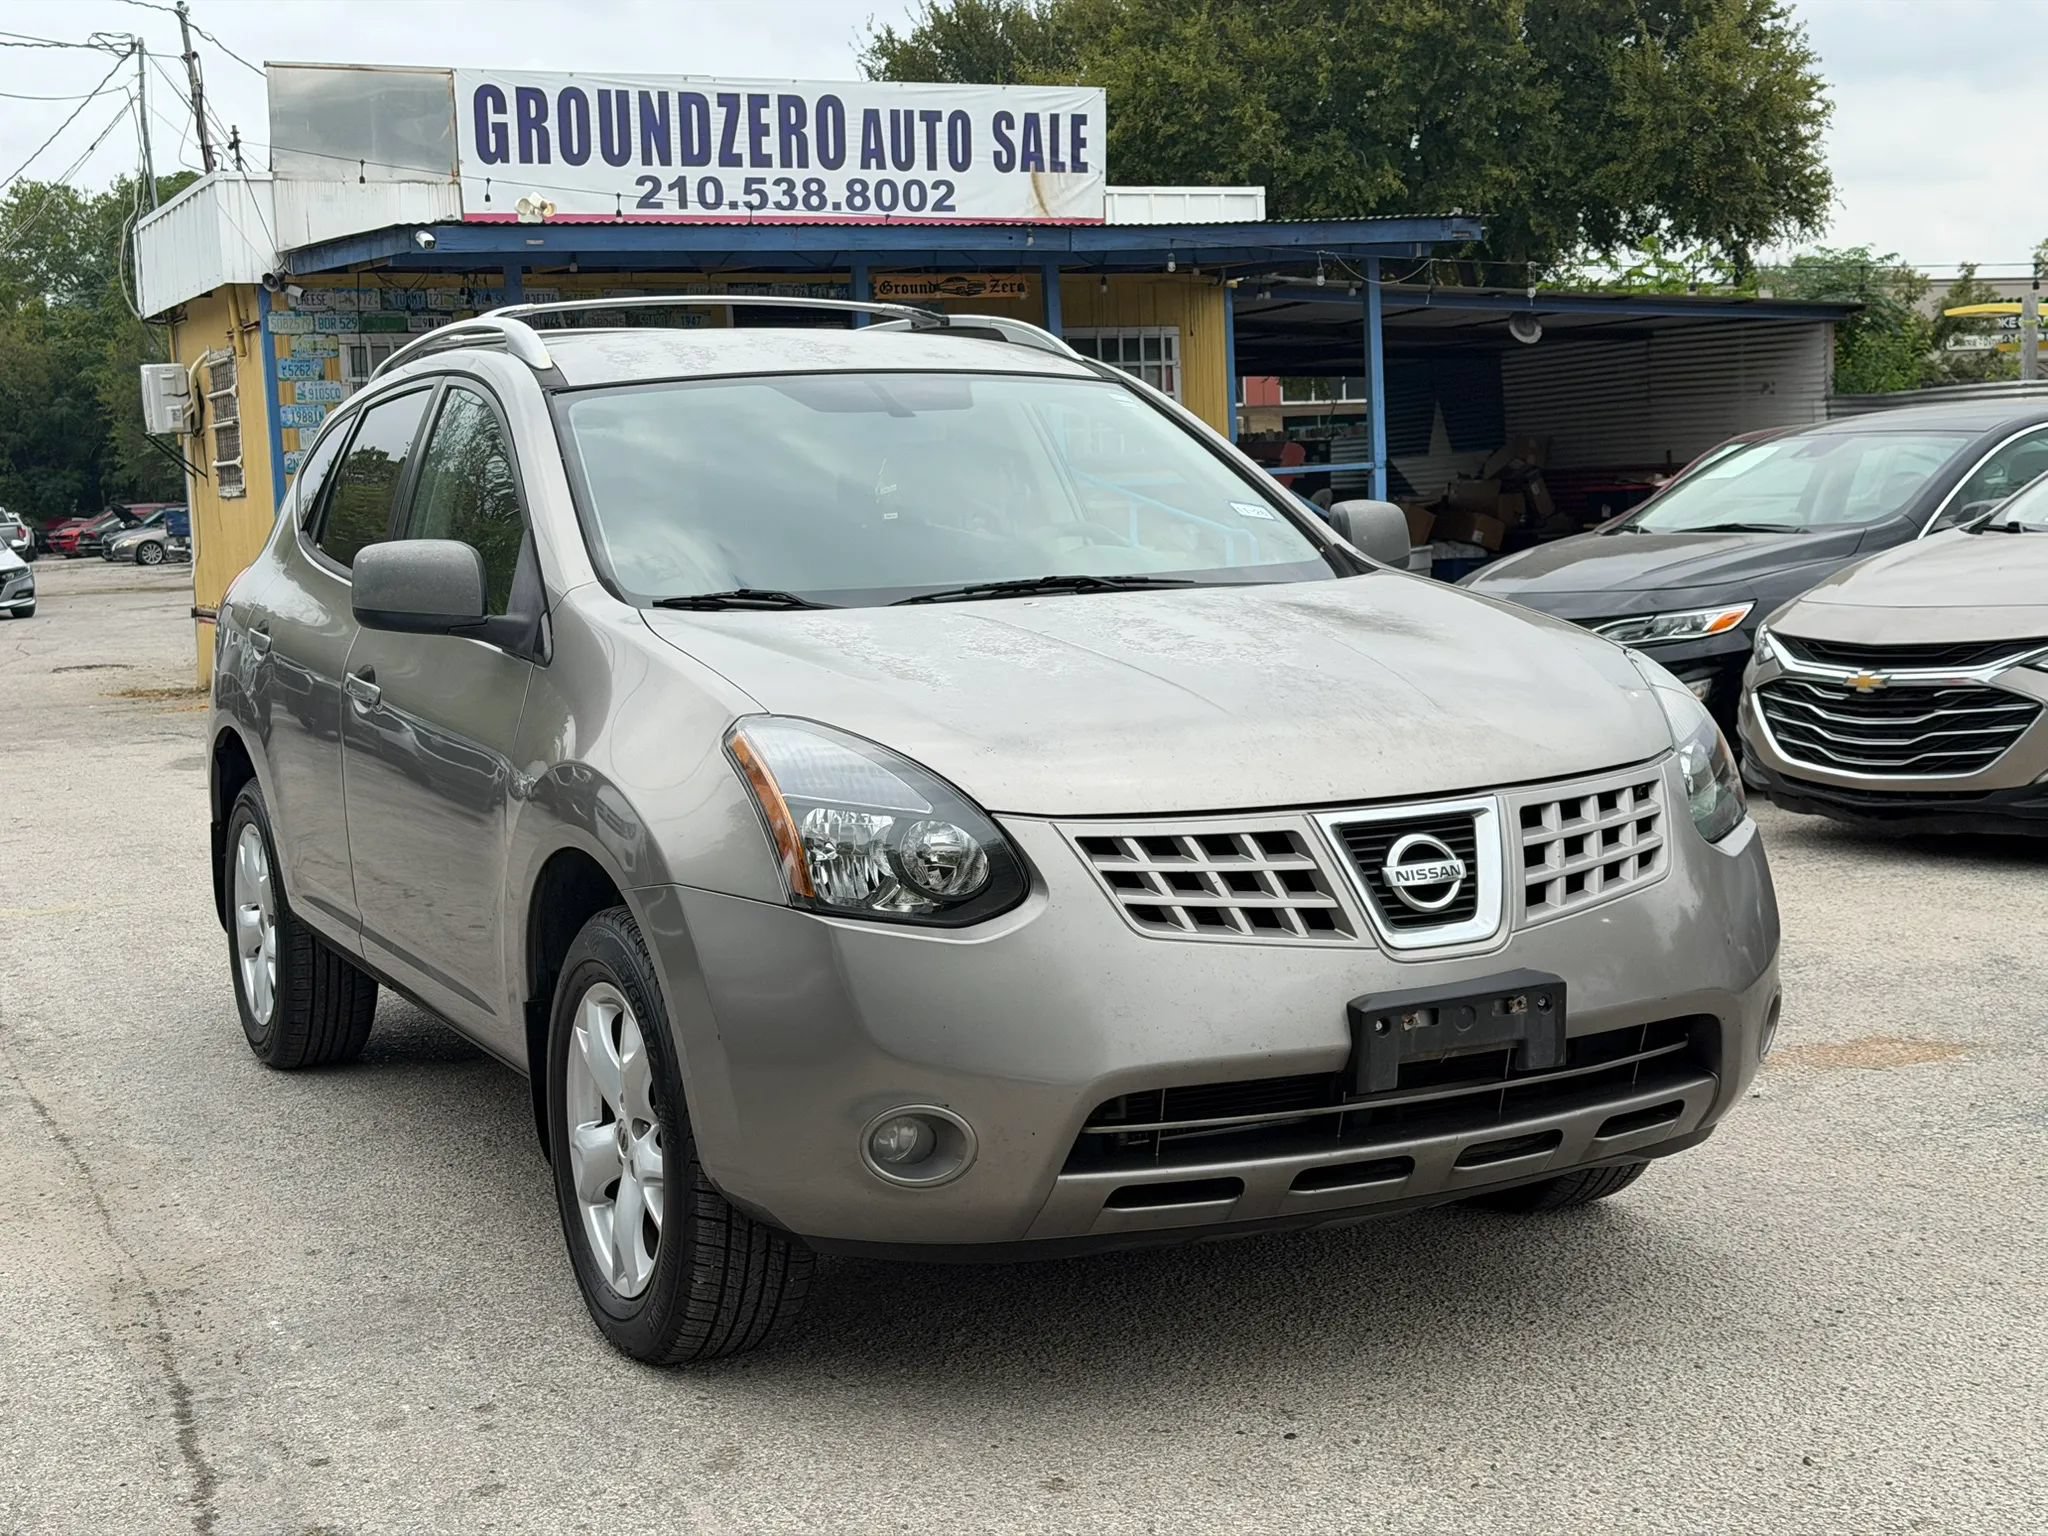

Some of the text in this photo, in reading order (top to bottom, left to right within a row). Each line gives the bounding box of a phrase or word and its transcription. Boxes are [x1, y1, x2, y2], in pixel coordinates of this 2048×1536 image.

[472, 83, 1090, 174] GROUNDZERO AUTO SALE
[635, 174, 957, 213] 210.538.8002
[879, 280, 937, 295] Ground
[1395, 864, 1462, 883] NISSAN
